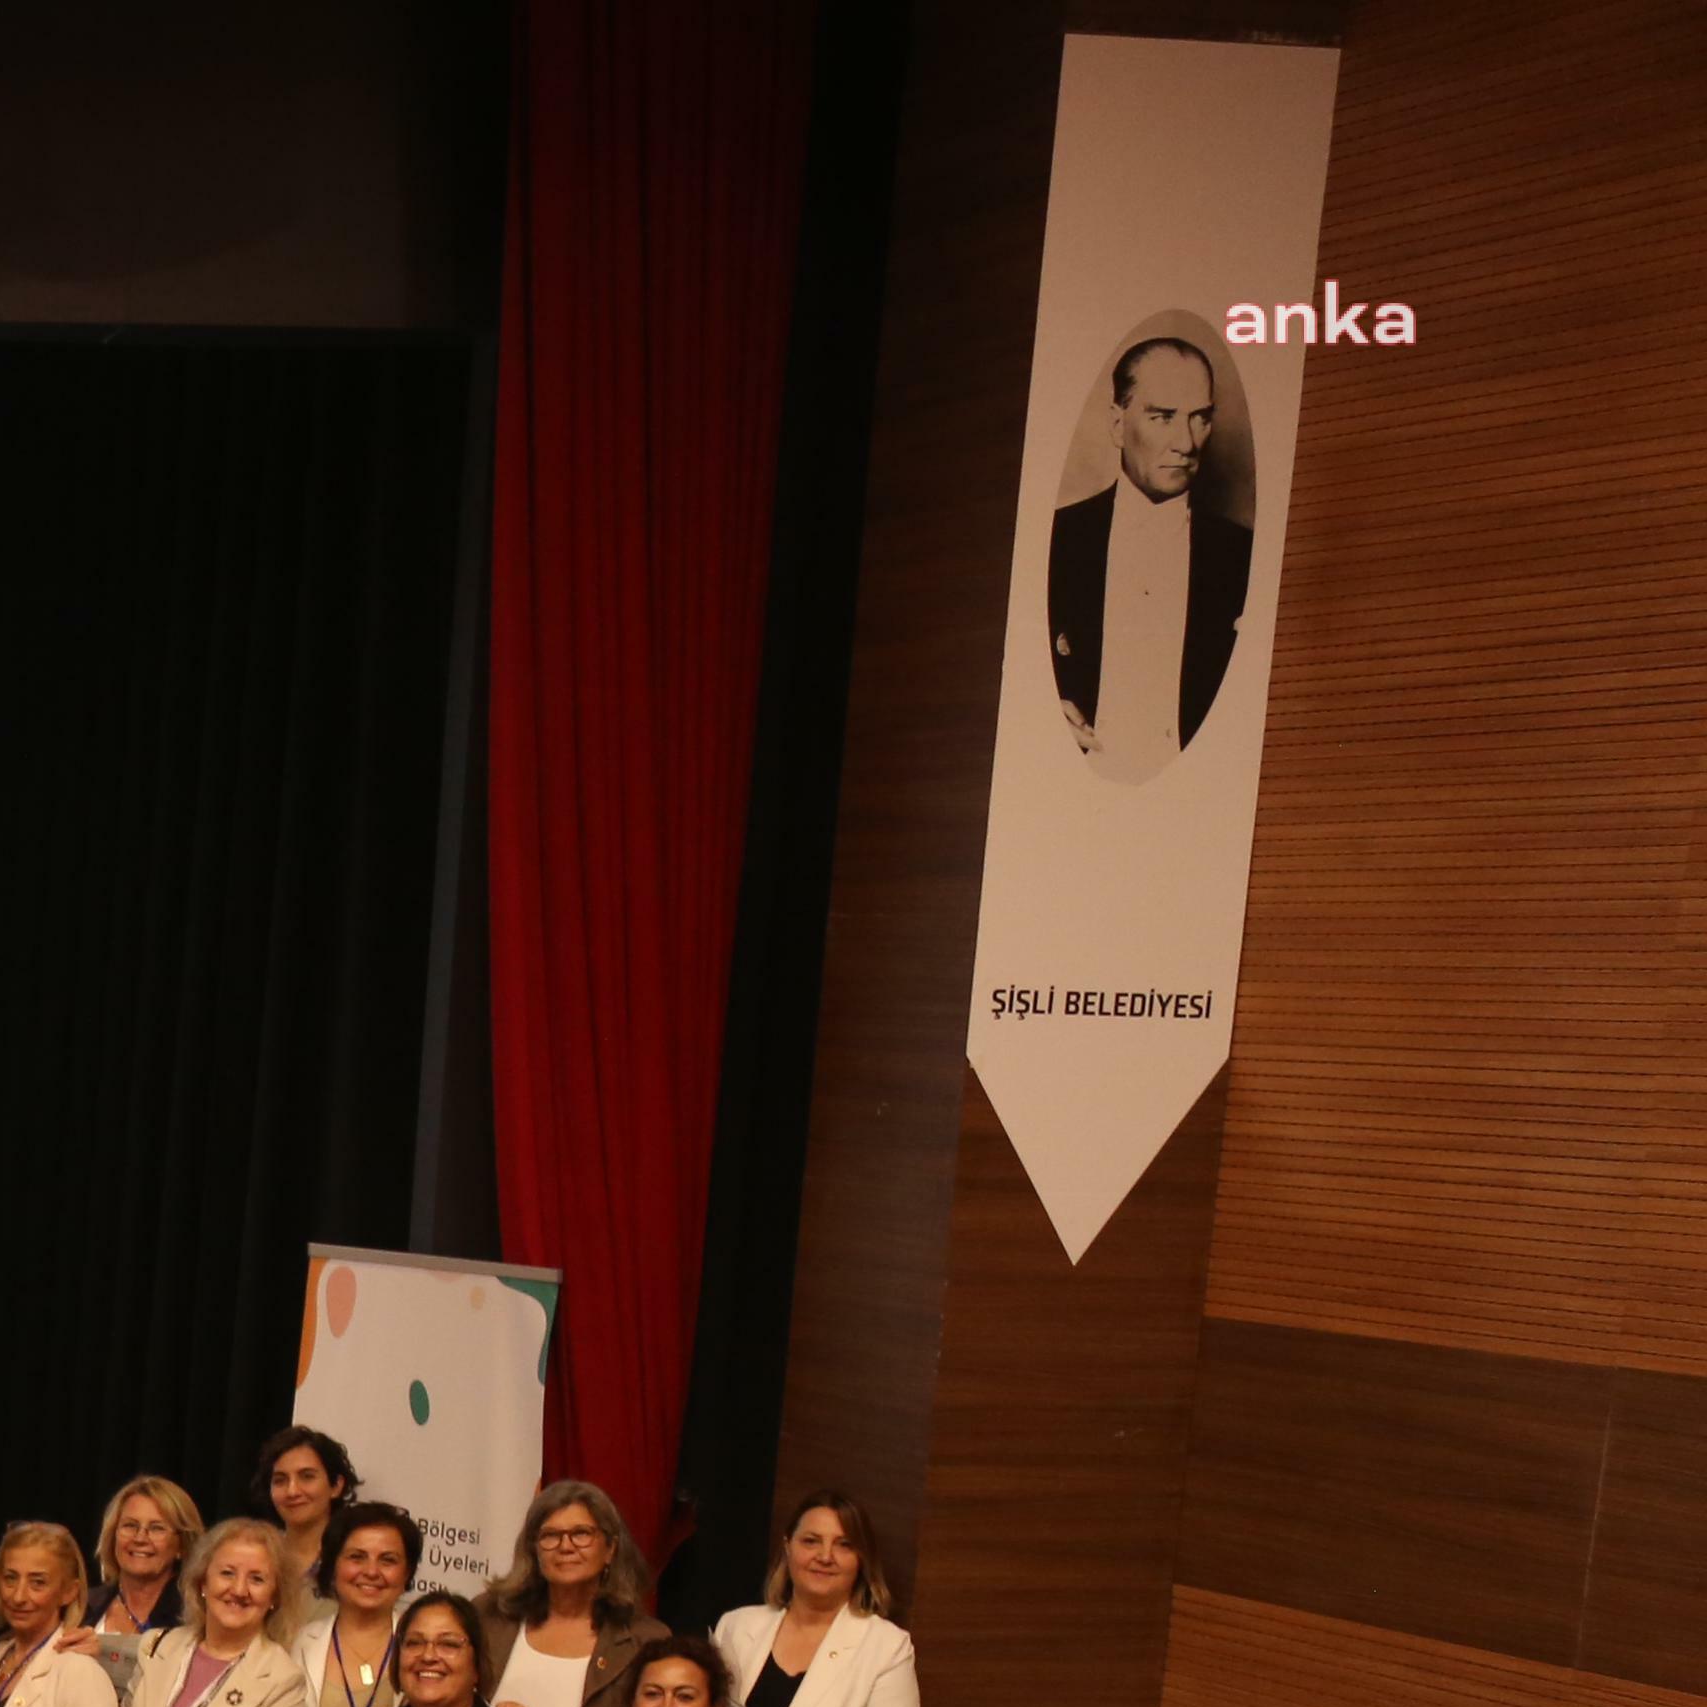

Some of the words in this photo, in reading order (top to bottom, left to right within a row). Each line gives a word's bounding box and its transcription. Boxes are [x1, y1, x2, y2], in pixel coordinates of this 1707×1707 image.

[991, 984, 1055, 1021] ŞİŞLİ
[1064, 988, 1213, 1020] BELEDİYESİ
[418, 1518, 480, 1547] Bölgesi
[429, 1544, 490, 1577] Üyeleri
